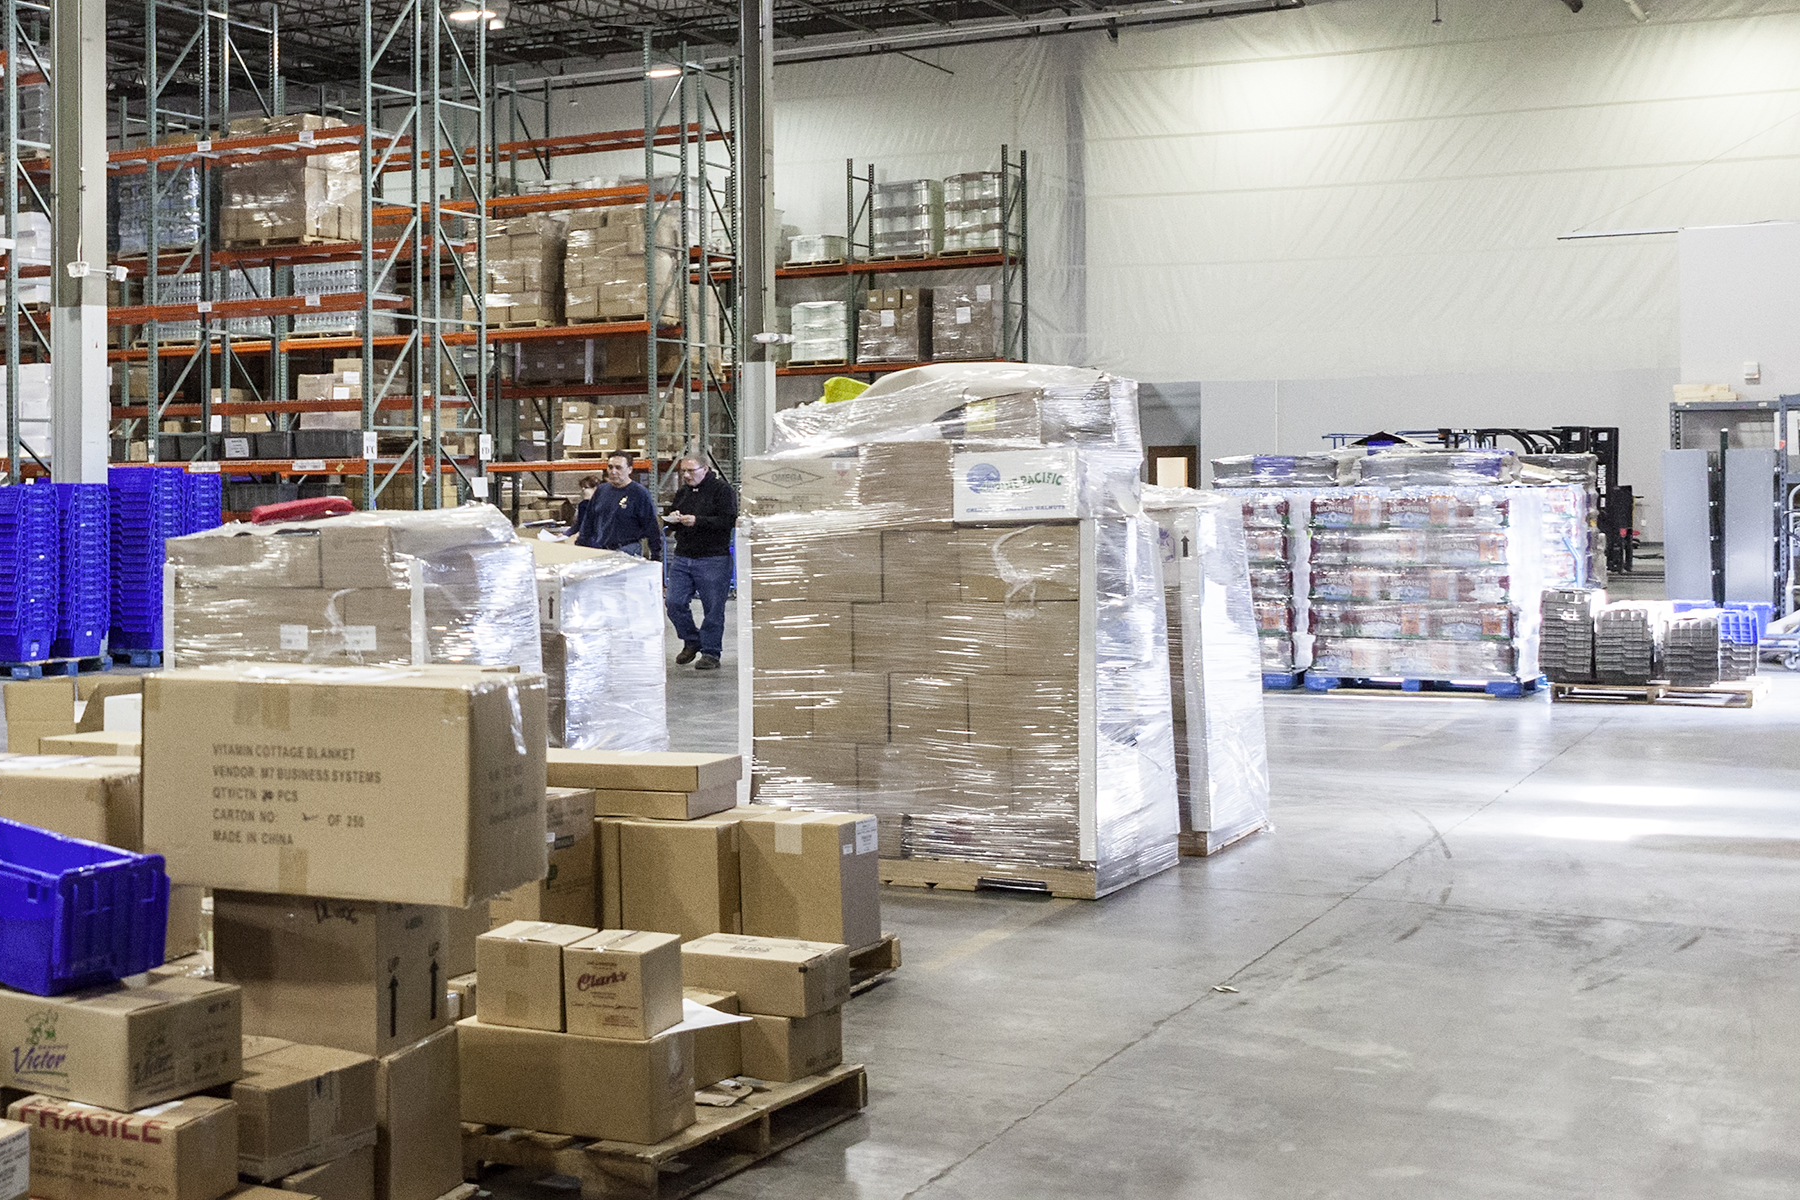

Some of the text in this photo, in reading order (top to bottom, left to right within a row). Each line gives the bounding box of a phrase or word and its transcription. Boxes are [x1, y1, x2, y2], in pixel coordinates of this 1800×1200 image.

[771, 473, 803, 482] OMEGA
[1019, 471, 1064, 486] PACIFIC
[1315, 505, 1353, 513] ARROWHEAD
[1389, 505, 1430, 514] ARROWHEAD
[1315, 577, 1353, 586] ARROWHEAD
[1390, 579, 1430, 588] ARROWHEAD
[1442, 615, 1482, 625] ARROWHEAD
[212, 743, 355, 760] VITAMIN COTTAGE BLANKET
[277, 768, 330, 782] BUSINESS
[332, 770, 382, 784] SYSTEMS
[277, 790, 299, 803] PCS
[212, 808, 255, 822] CARTON
[327, 814, 341, 826] OF
[346, 815, 365, 828] 250
[212, 830, 294, 845] MADE IN CHINA
[576, 971, 629, 992] Clark's
[13, 1046, 66, 1074] Victor
[19, 1101, 168, 1145] FRAGILE
